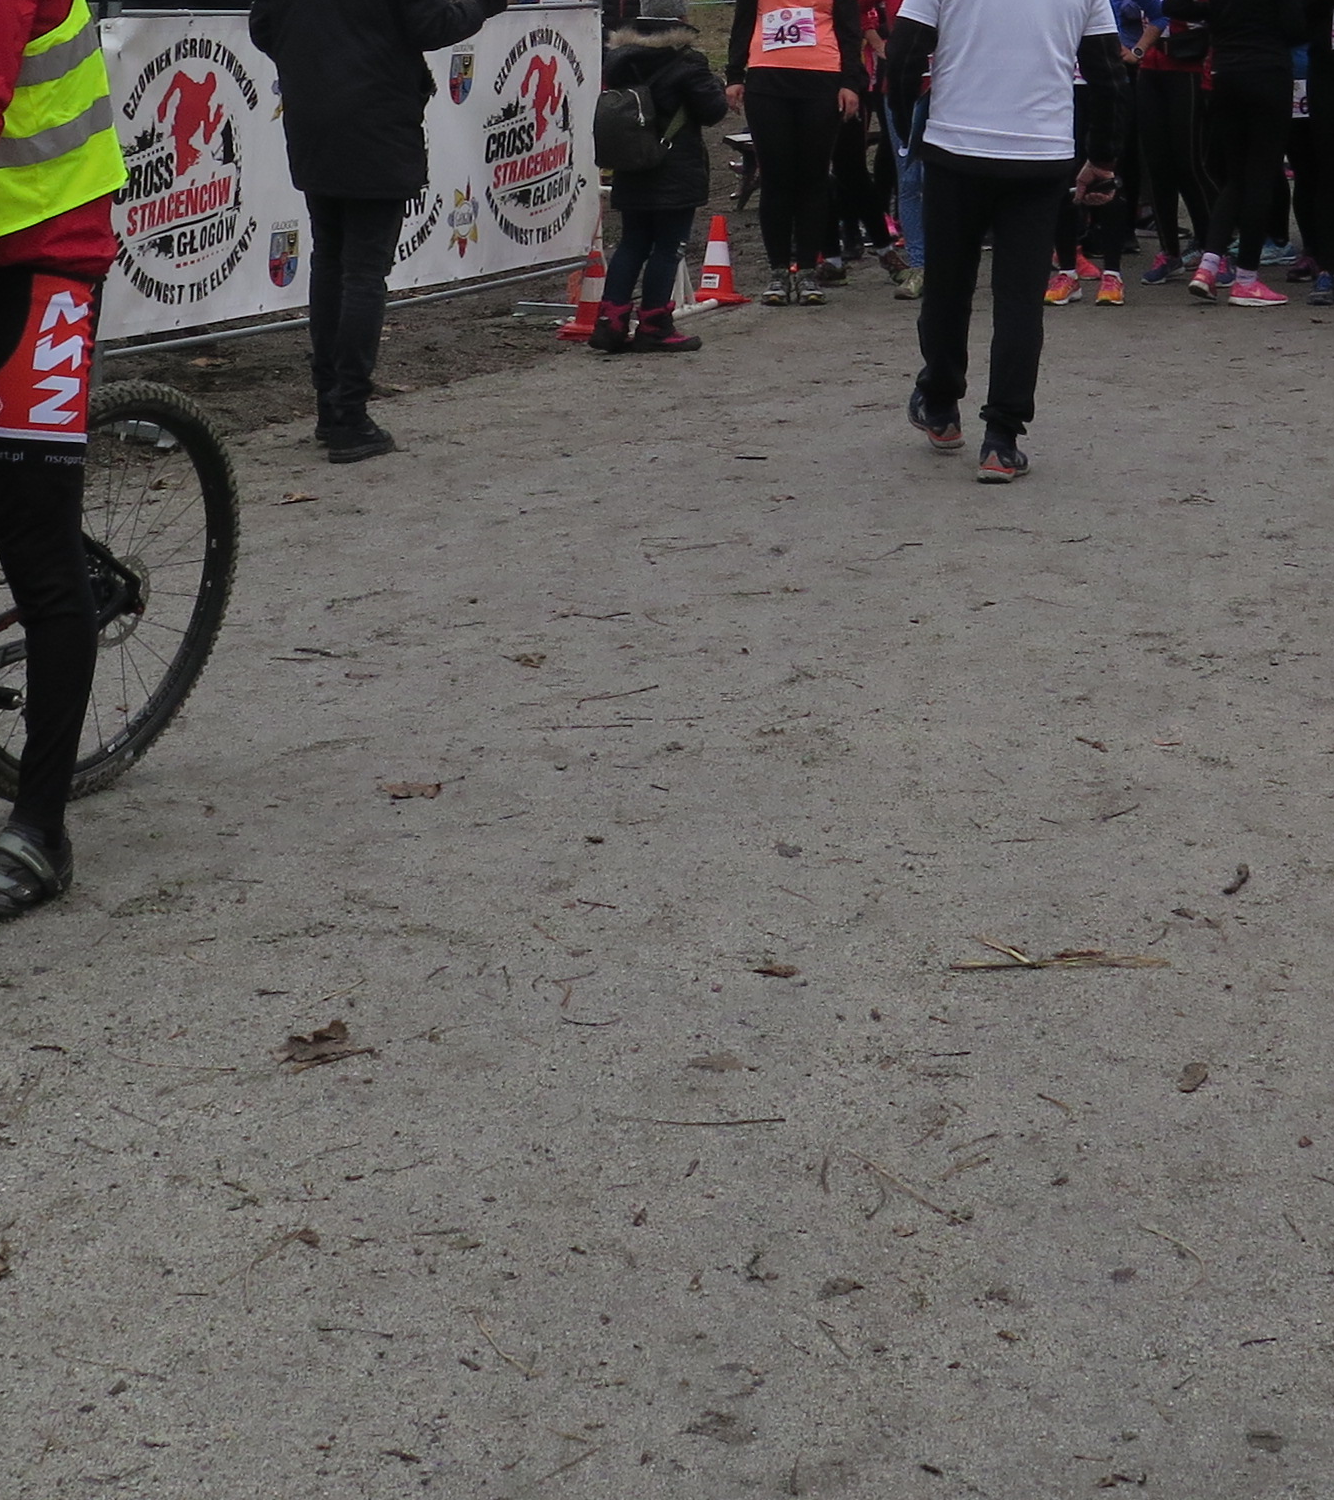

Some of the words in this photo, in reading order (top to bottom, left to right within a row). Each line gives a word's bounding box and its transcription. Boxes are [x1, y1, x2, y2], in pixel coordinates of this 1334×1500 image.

[773, 24, 801, 45] 49
[484, 121, 535, 164] CROSS
[188, 278, 210, 304] THE
